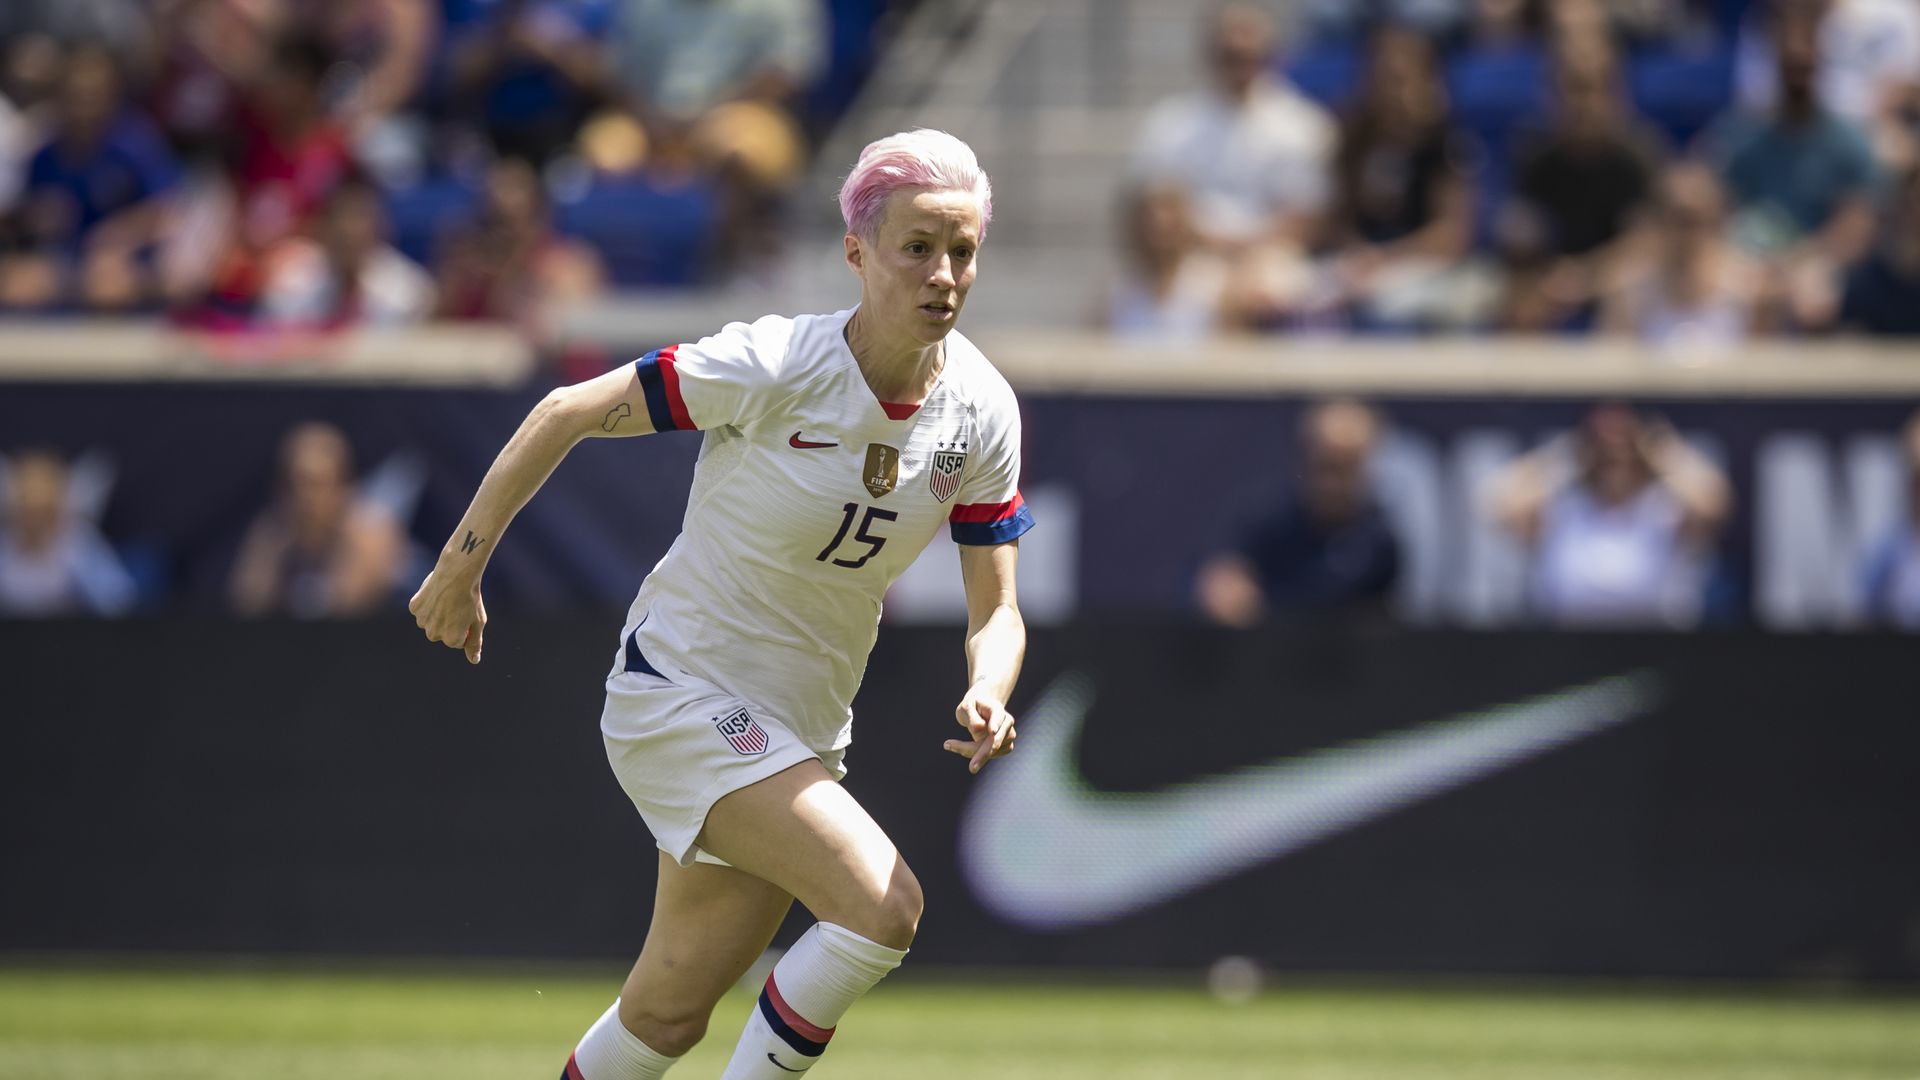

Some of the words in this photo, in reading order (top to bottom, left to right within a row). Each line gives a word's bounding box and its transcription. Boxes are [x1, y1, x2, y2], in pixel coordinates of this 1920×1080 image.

[936, 456, 964, 474] USA
[871, 477, 888, 487] FIFA
[461, 530, 485, 555] W
[816, 502, 898, 568] 15
[721, 712, 750, 735] USA
